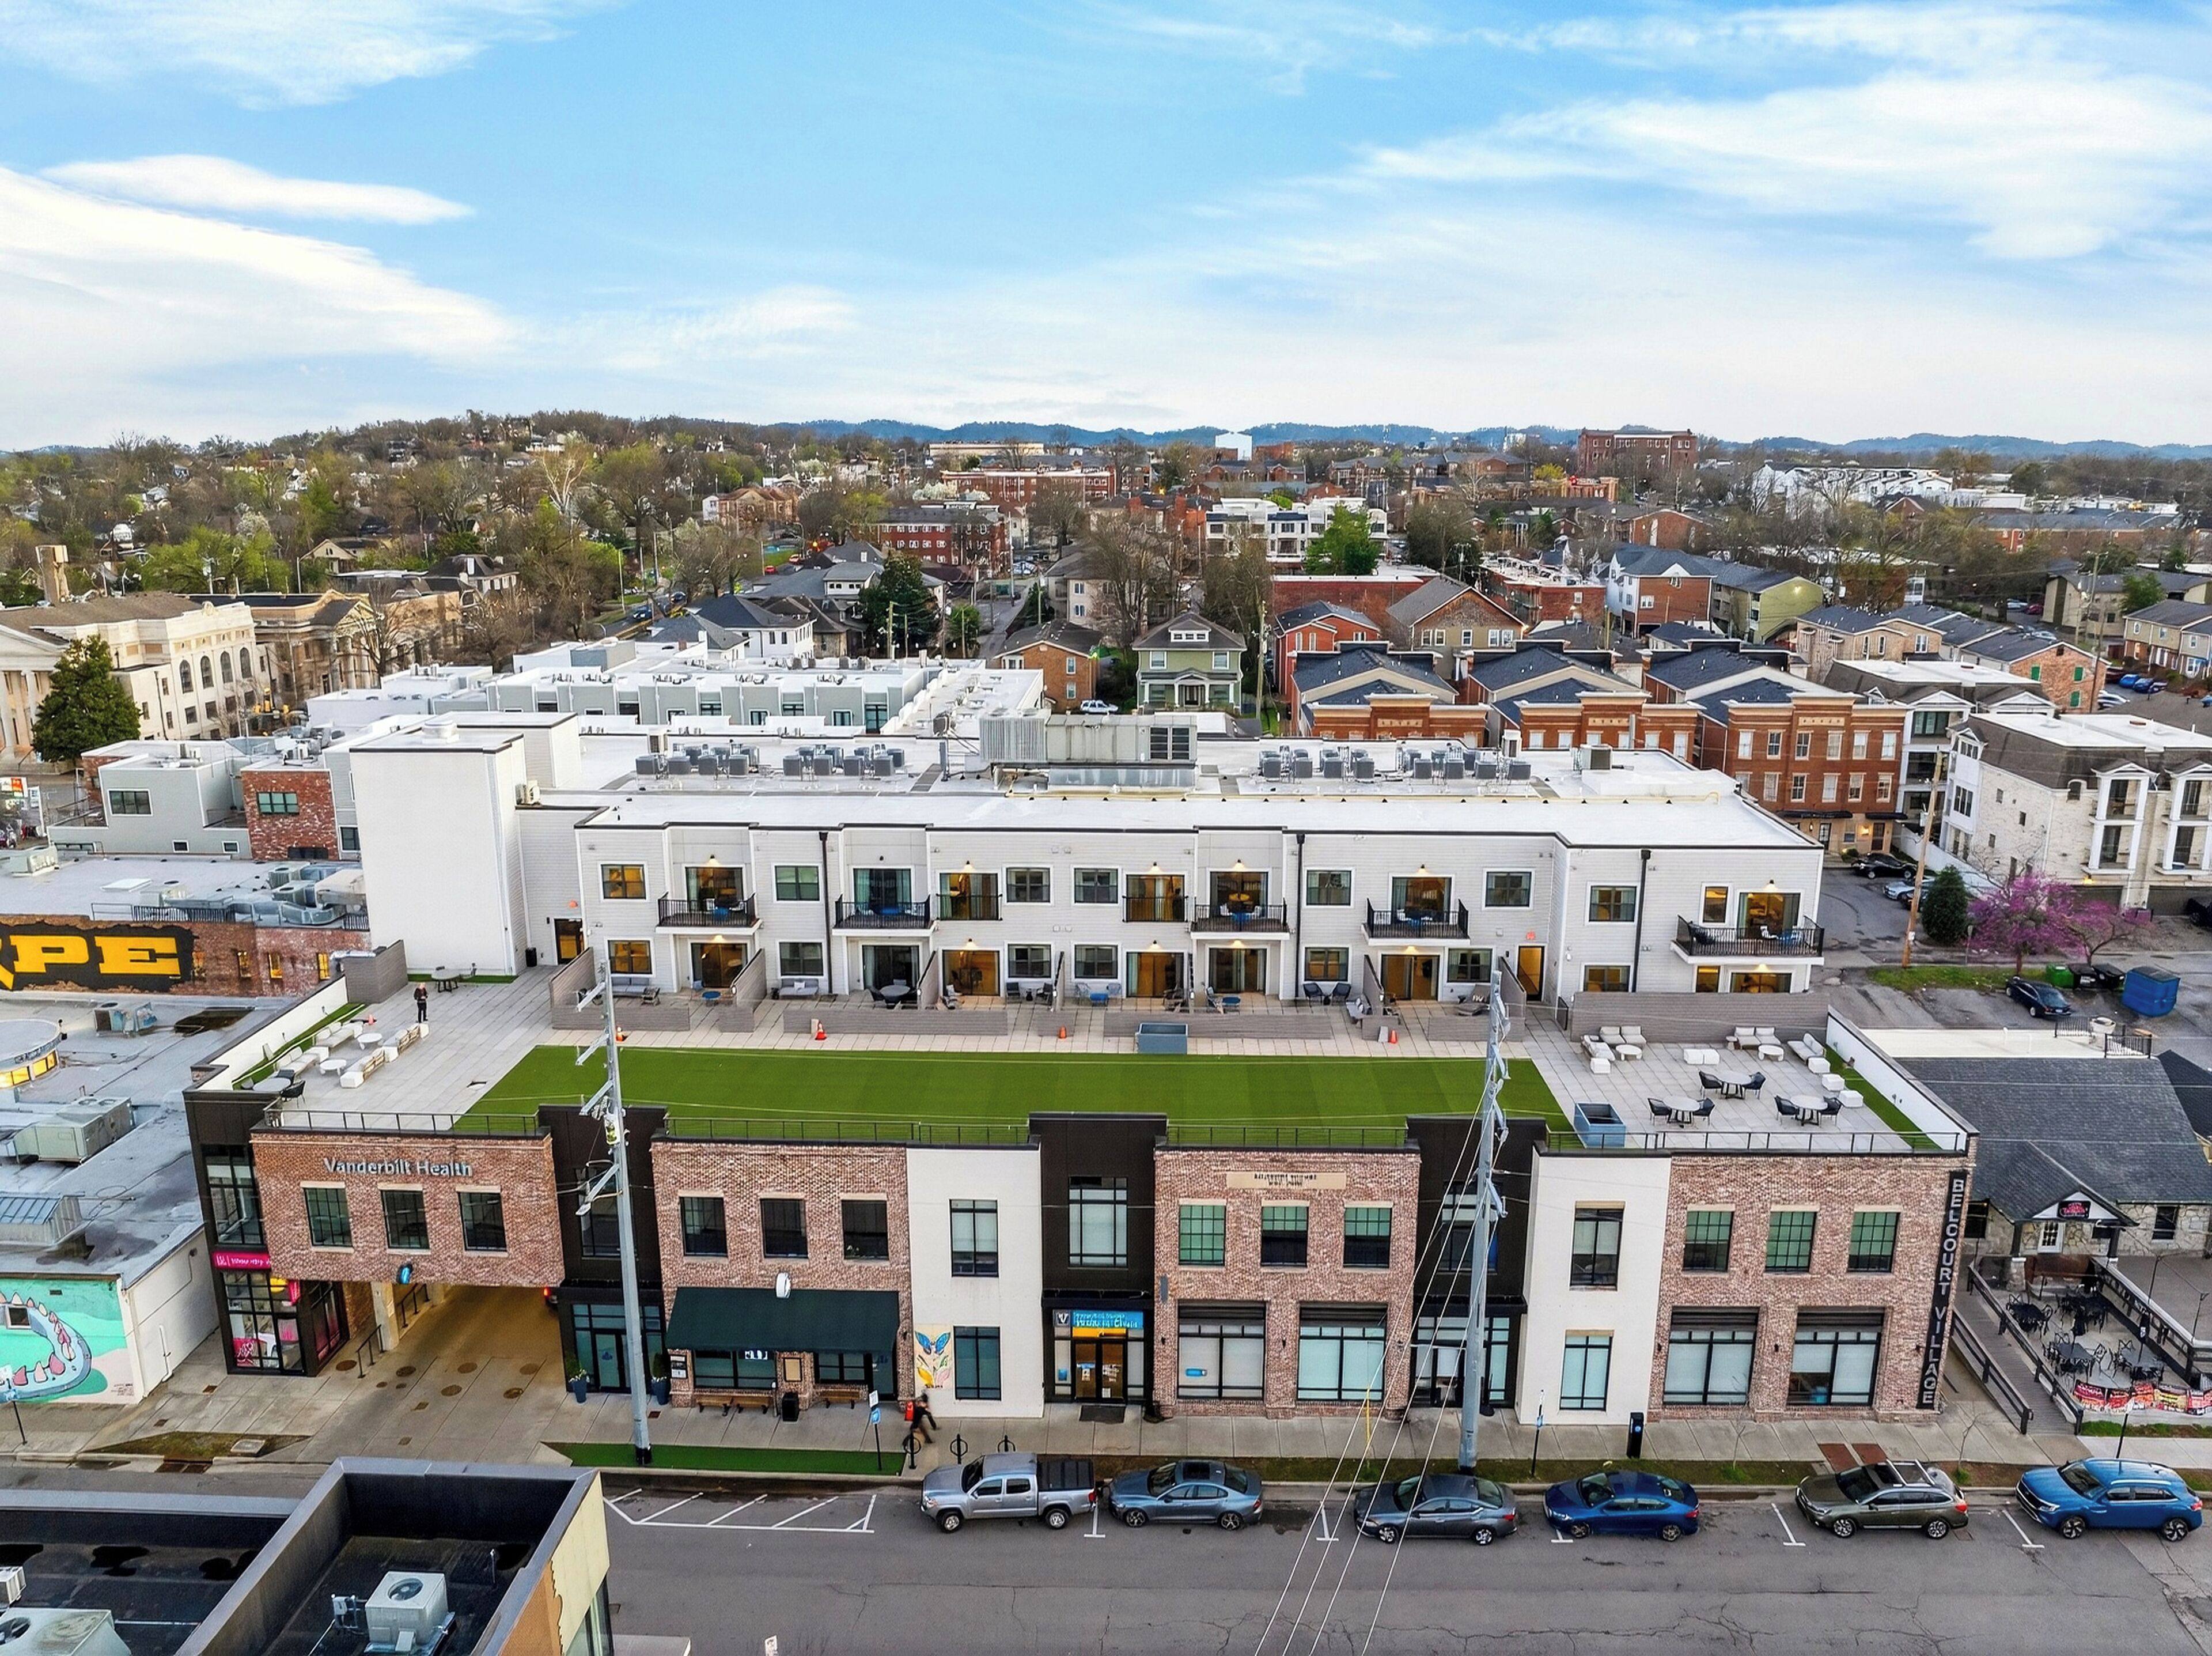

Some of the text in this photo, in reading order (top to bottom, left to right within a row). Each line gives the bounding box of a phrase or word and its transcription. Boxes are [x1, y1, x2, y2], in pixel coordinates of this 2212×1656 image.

[0, 935, 181, 990] PE
[324, 1157, 474, 1178] Vanderbilt Health
[1922, 1179, 1964, 1404] BELCOURT VILLAGE
